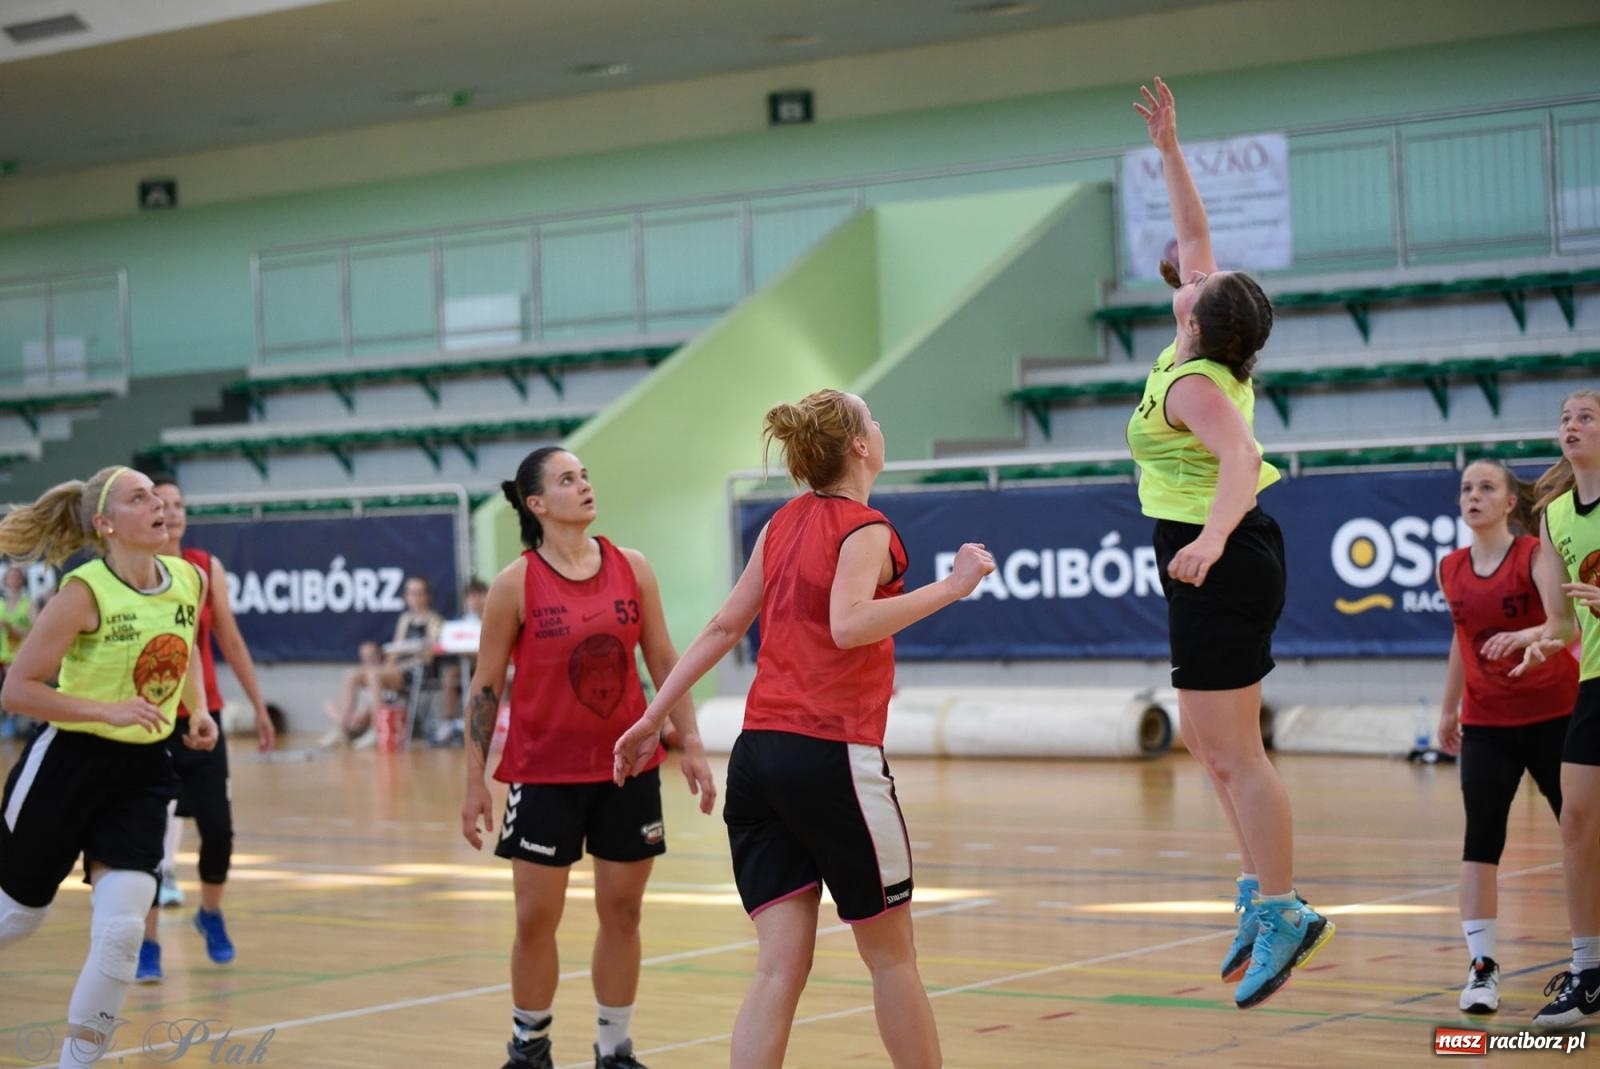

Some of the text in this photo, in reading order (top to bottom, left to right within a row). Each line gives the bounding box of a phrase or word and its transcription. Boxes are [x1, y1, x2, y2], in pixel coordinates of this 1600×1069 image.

[175, 604, 195, 628] 48
[614, 599, 640, 625] 53
[519, 837, 557, 857] hummel
